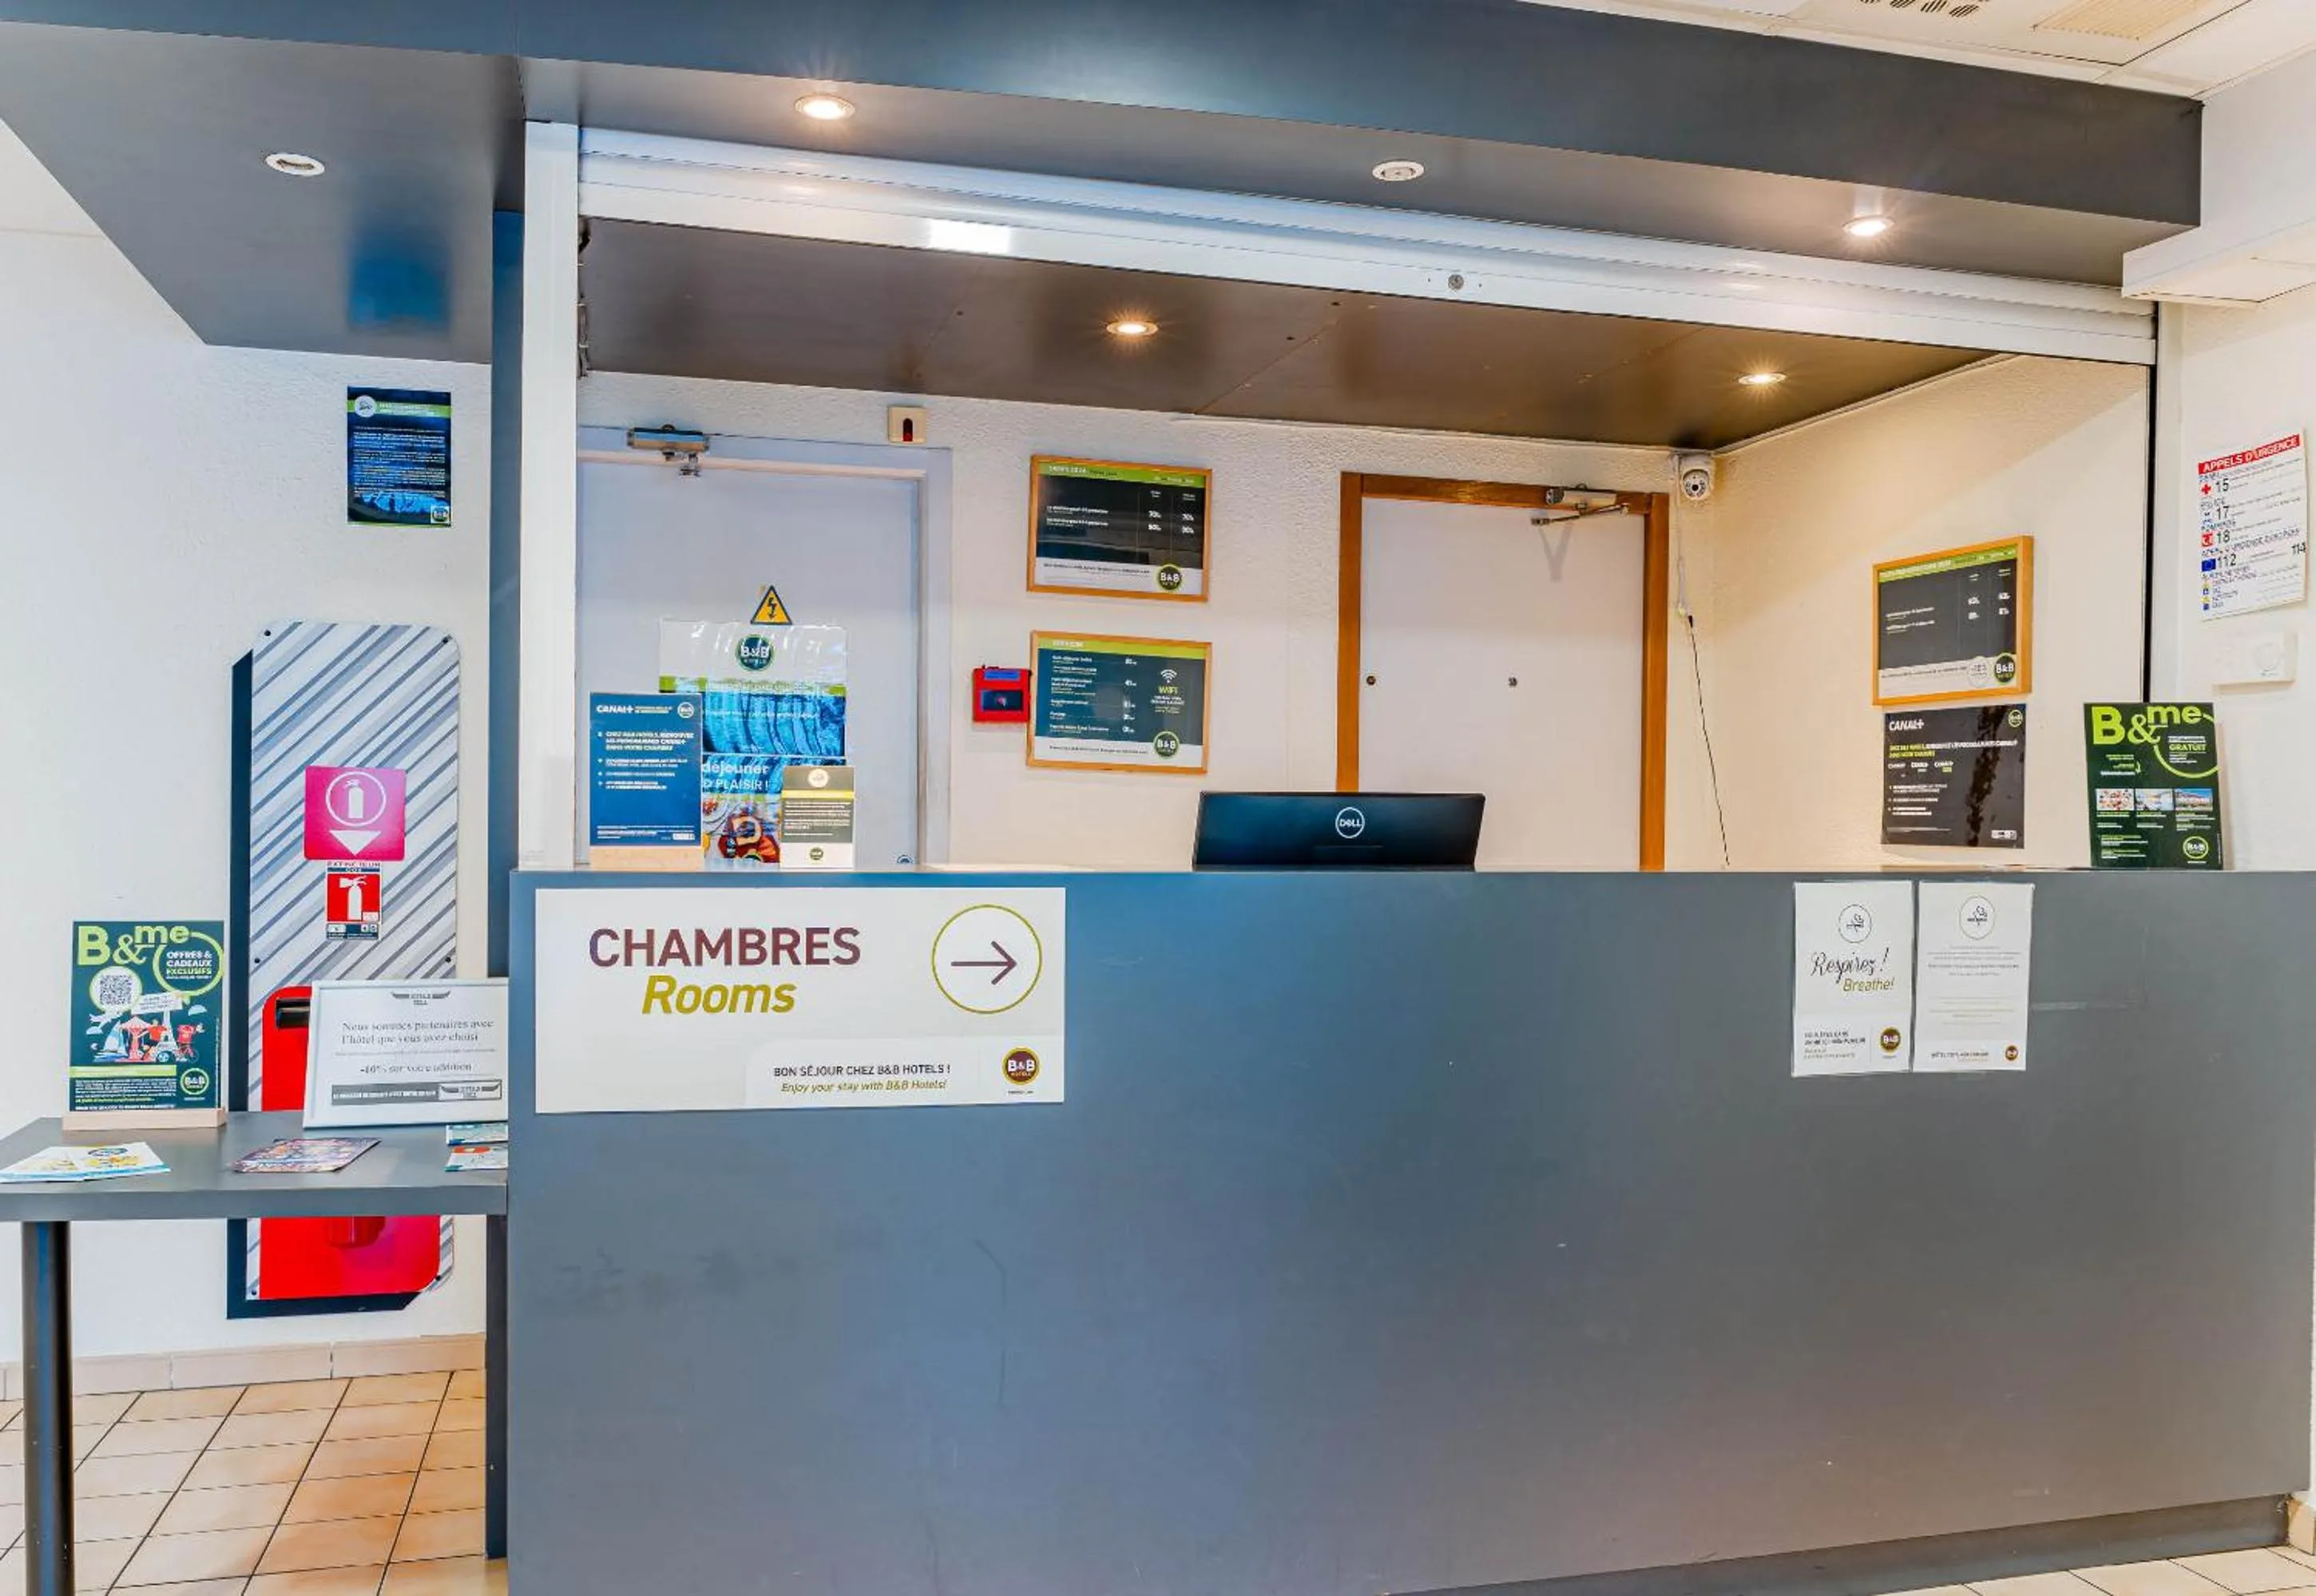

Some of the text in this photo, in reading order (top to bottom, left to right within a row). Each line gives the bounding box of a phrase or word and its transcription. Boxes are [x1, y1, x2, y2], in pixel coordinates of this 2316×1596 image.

[2203, 438, 2298, 473] APPELS D'URGENCE
[2215, 478, 2229, 492] 15
[2216, 505, 2229, 520] 17
[2217, 529, 2231, 544] 18
[2218, 553, 2236, 568] 112
[1160, 572, 1180, 583] B&B
[741, 646, 769, 658] B&B
[1996, 663, 2014, 674] B&B
[1889, 719, 1924, 731] CANAL+
[1157, 739, 1176, 749] B&B
[716, 779, 763, 790] PLAISIR
[1339, 818, 1362, 828] DELL
[77, 925, 190, 966] B&me
[589, 927, 862, 968] CHAMBRES
[641, 974, 797, 1016] Rooms
[774, 1067, 797, 1076] BON
[800, 1065, 843, 1076] SÉJOUR
[846, 1066, 874, 1075] CHEZ
[878, 1065, 900, 1075] B&B
[902, 1064, 944, 1075] HOTELS
[1007, 1059, 1035, 1071] B&B
[781, 1079, 948, 1094] Enjoy your stay with B&B Hotels!
